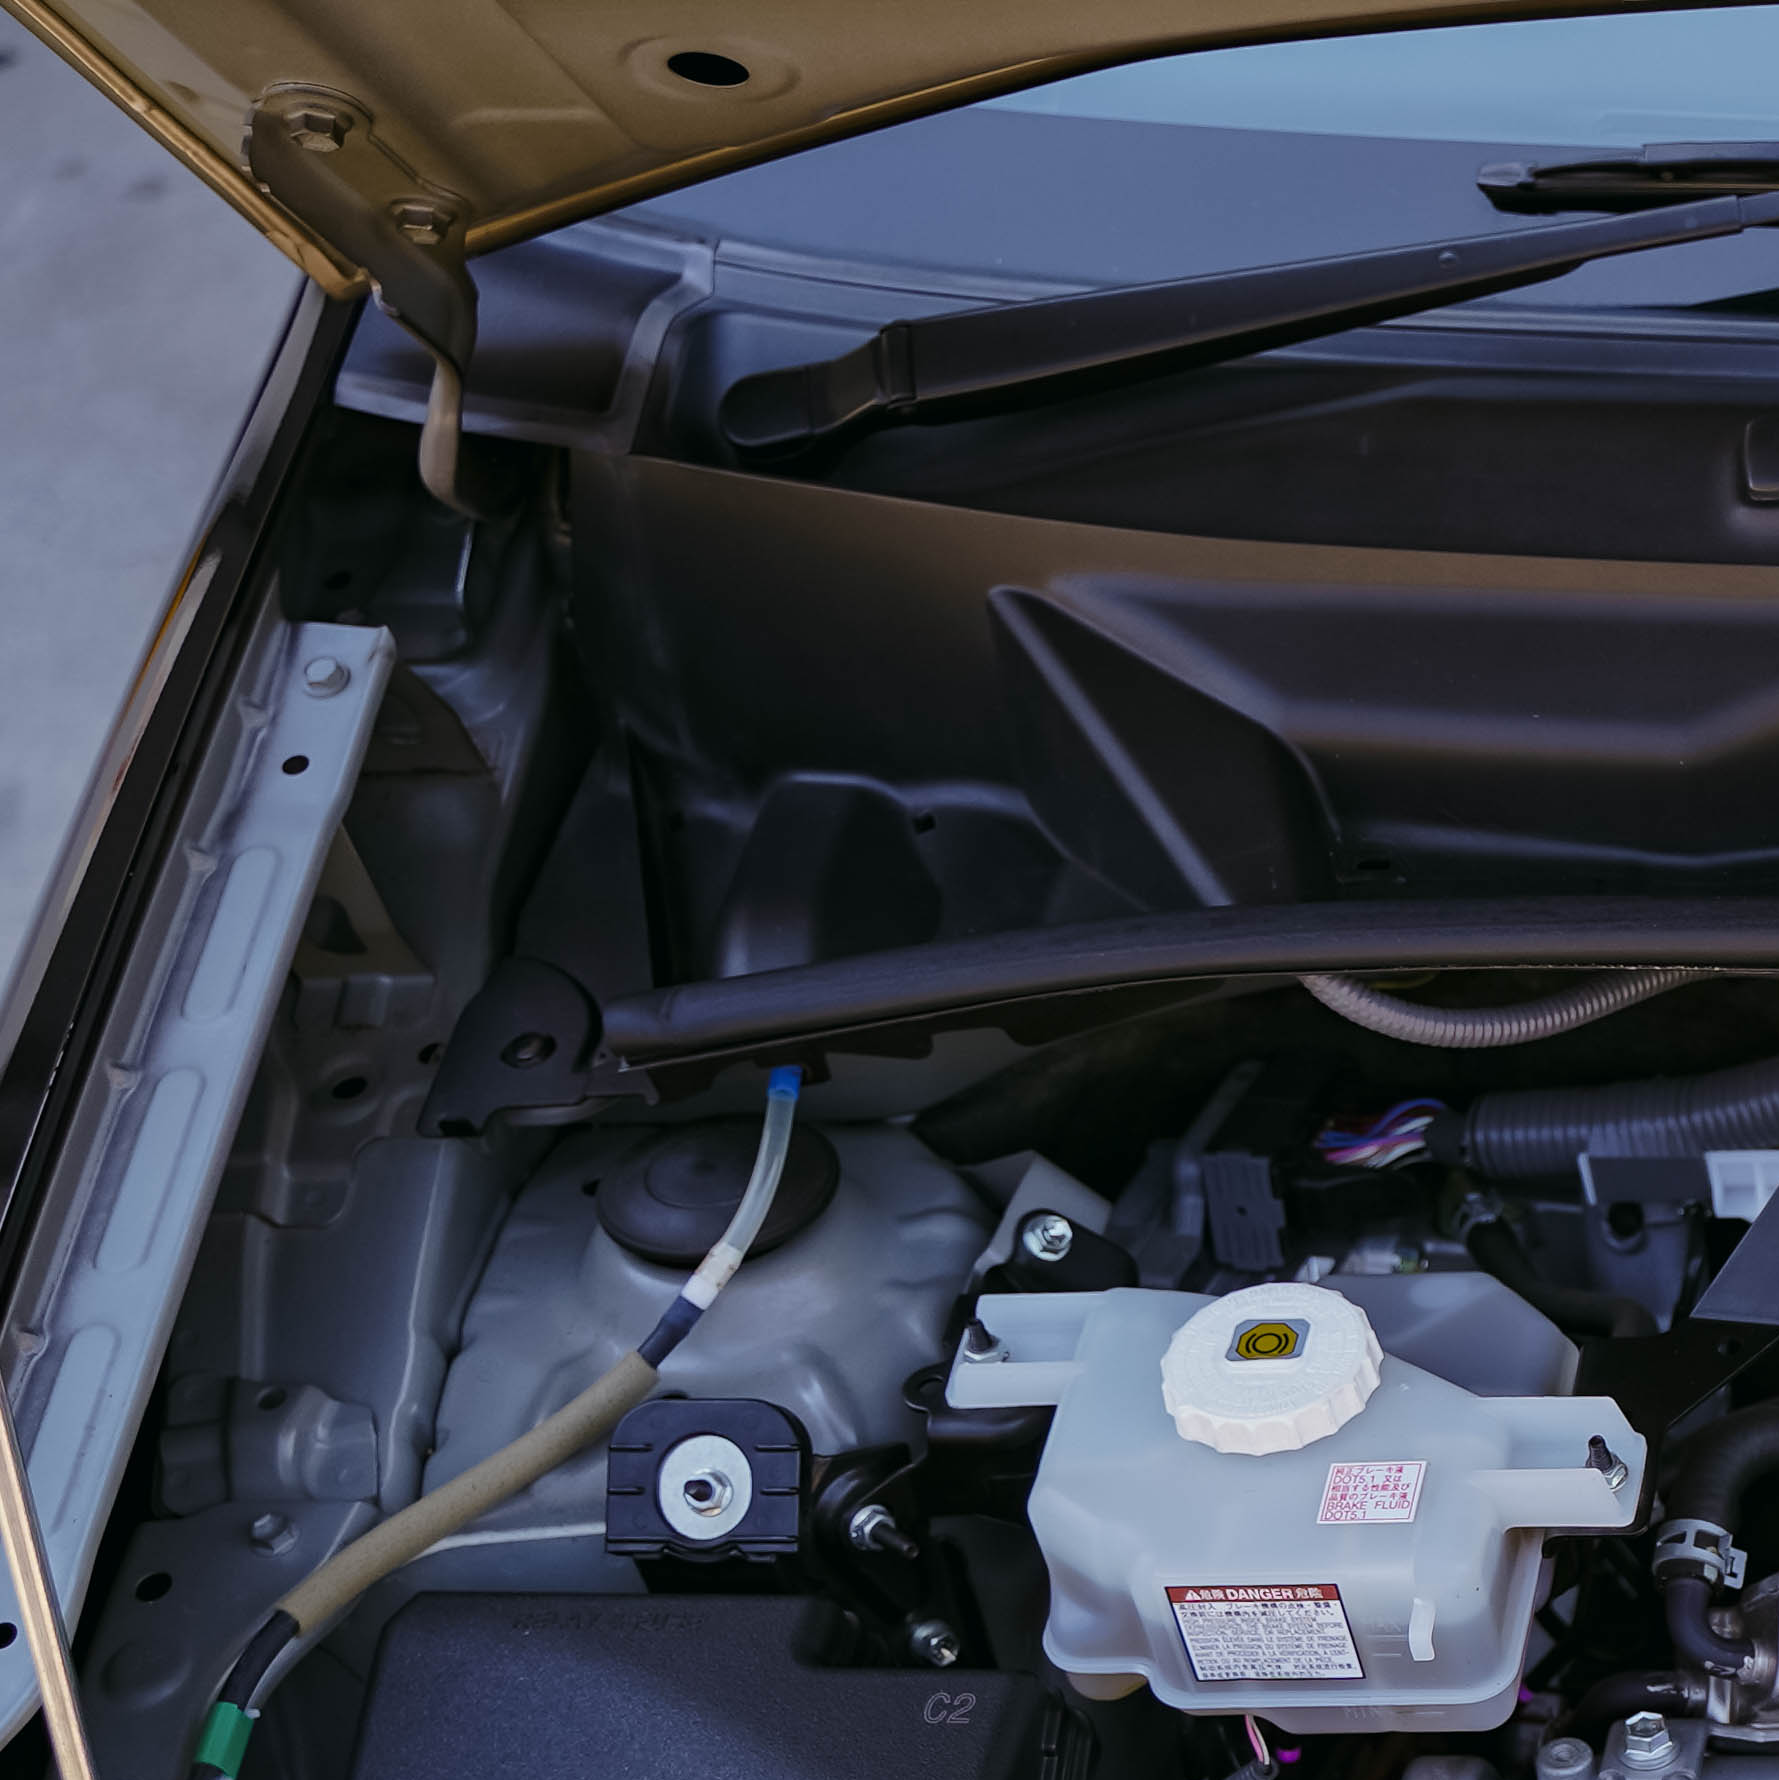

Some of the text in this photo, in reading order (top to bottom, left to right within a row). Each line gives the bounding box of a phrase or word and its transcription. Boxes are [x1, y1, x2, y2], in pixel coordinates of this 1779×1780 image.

[1333, 1474, 1375, 1483] DOT5.1
[1326, 1500, 1410, 1510] BRAKE FLUID
[1324, 1510, 1366, 1519] DOT5.1
[1224, 1587, 1294, 1599] DANGER
[922, 1690, 978, 1725] C2
